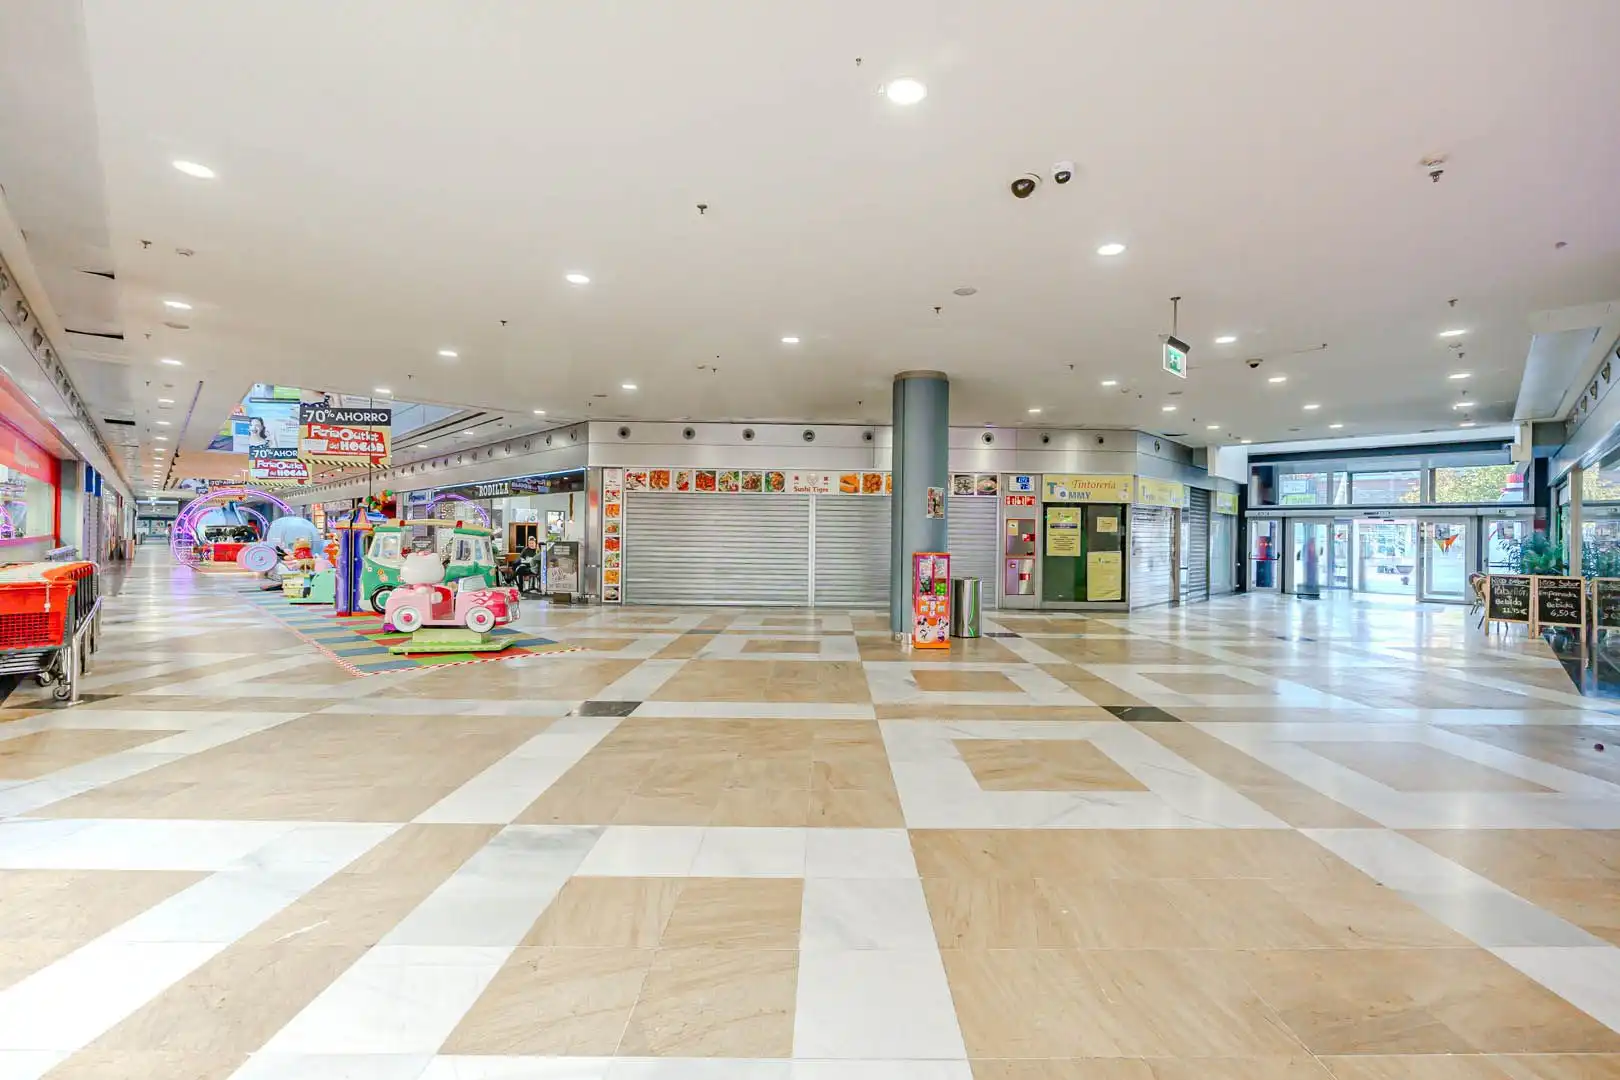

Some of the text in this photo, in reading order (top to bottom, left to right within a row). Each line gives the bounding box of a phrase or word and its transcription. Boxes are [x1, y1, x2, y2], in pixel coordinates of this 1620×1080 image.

[303, 409, 389, 422] -70% AHORRO
[475, 482, 509, 497] RODILLA
[793, 485, 811, 493] Sushi
